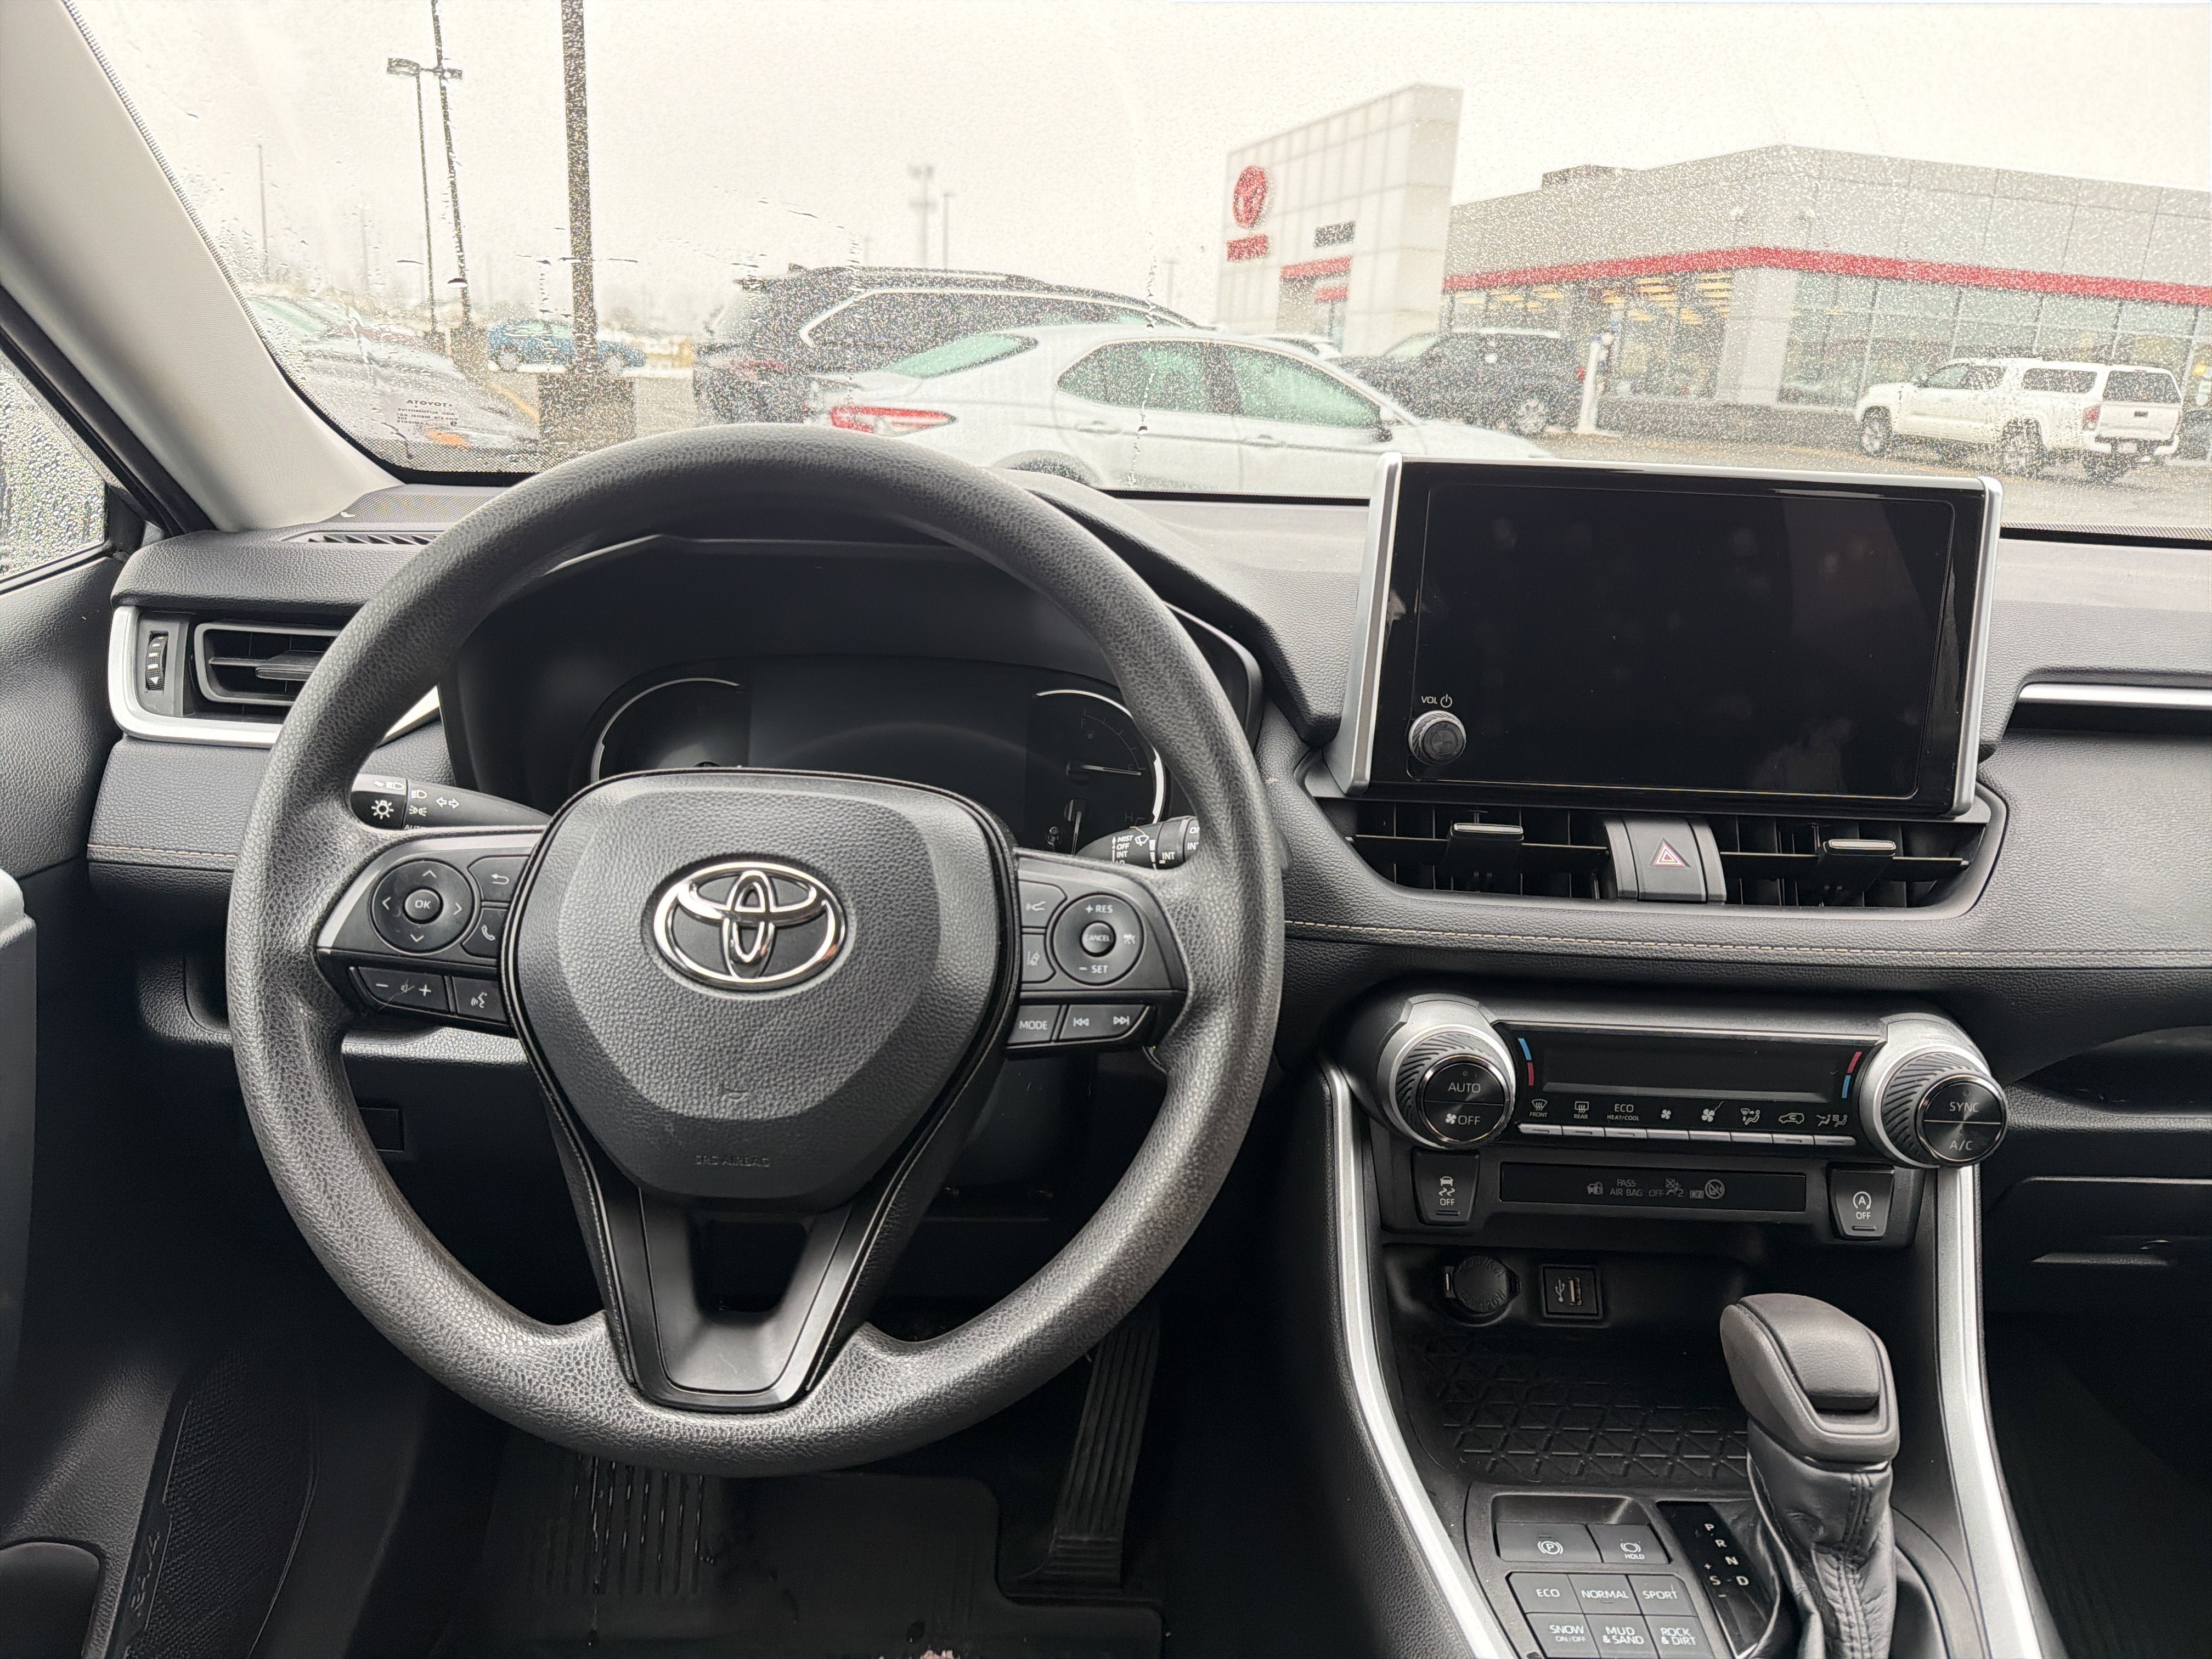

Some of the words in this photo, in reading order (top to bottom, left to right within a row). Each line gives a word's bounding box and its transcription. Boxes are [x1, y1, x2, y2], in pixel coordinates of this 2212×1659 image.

[1421, 695, 1438, 704] VOL
[1116, 850, 1128, 859] INT
[1161, 851, 1176, 860] INT
[415, 900, 431, 909] OK
[1095, 904, 1113, 913] RES
[1086, 934, 1110, 942] CANCEL
[1091, 964, 1109, 974] SET
[1019, 1020, 1048, 1030] MODE
[1447, 1082, 1481, 1093] AUTO
[1614, 1104, 1634, 1113] ECO
[1949, 1102, 1979, 1113] SYNC
[1457, 1114, 1481, 1126] OFF
[1949, 1141, 1973, 1151] A/C
[1617, 1178, 1636, 1187] PASS
[1626, 1189, 1643, 1197] BAG
[1439, 1198, 1455, 1206] OFF
[1855, 1212, 1871, 1220] OFF
[1725, 1556, 1739, 1565] N
[1709, 1575, 1721, 1585] S
[1736, 1576, 1749, 1585] D
[1536, 1589, 1560, 1598] ECO
[1581, 1590, 1629, 1599] NORMAL
[1642, 1590, 1678, 1599] SPORT
[1549, 1625, 1584, 1634] SNOW
[1605, 1627, 1635, 1636] MUD
[1661, 1628, 1691, 1637] ROCK
[1612, 1635, 1645, 1645] SAND
[1671, 1637, 1696, 1646] DIRT
